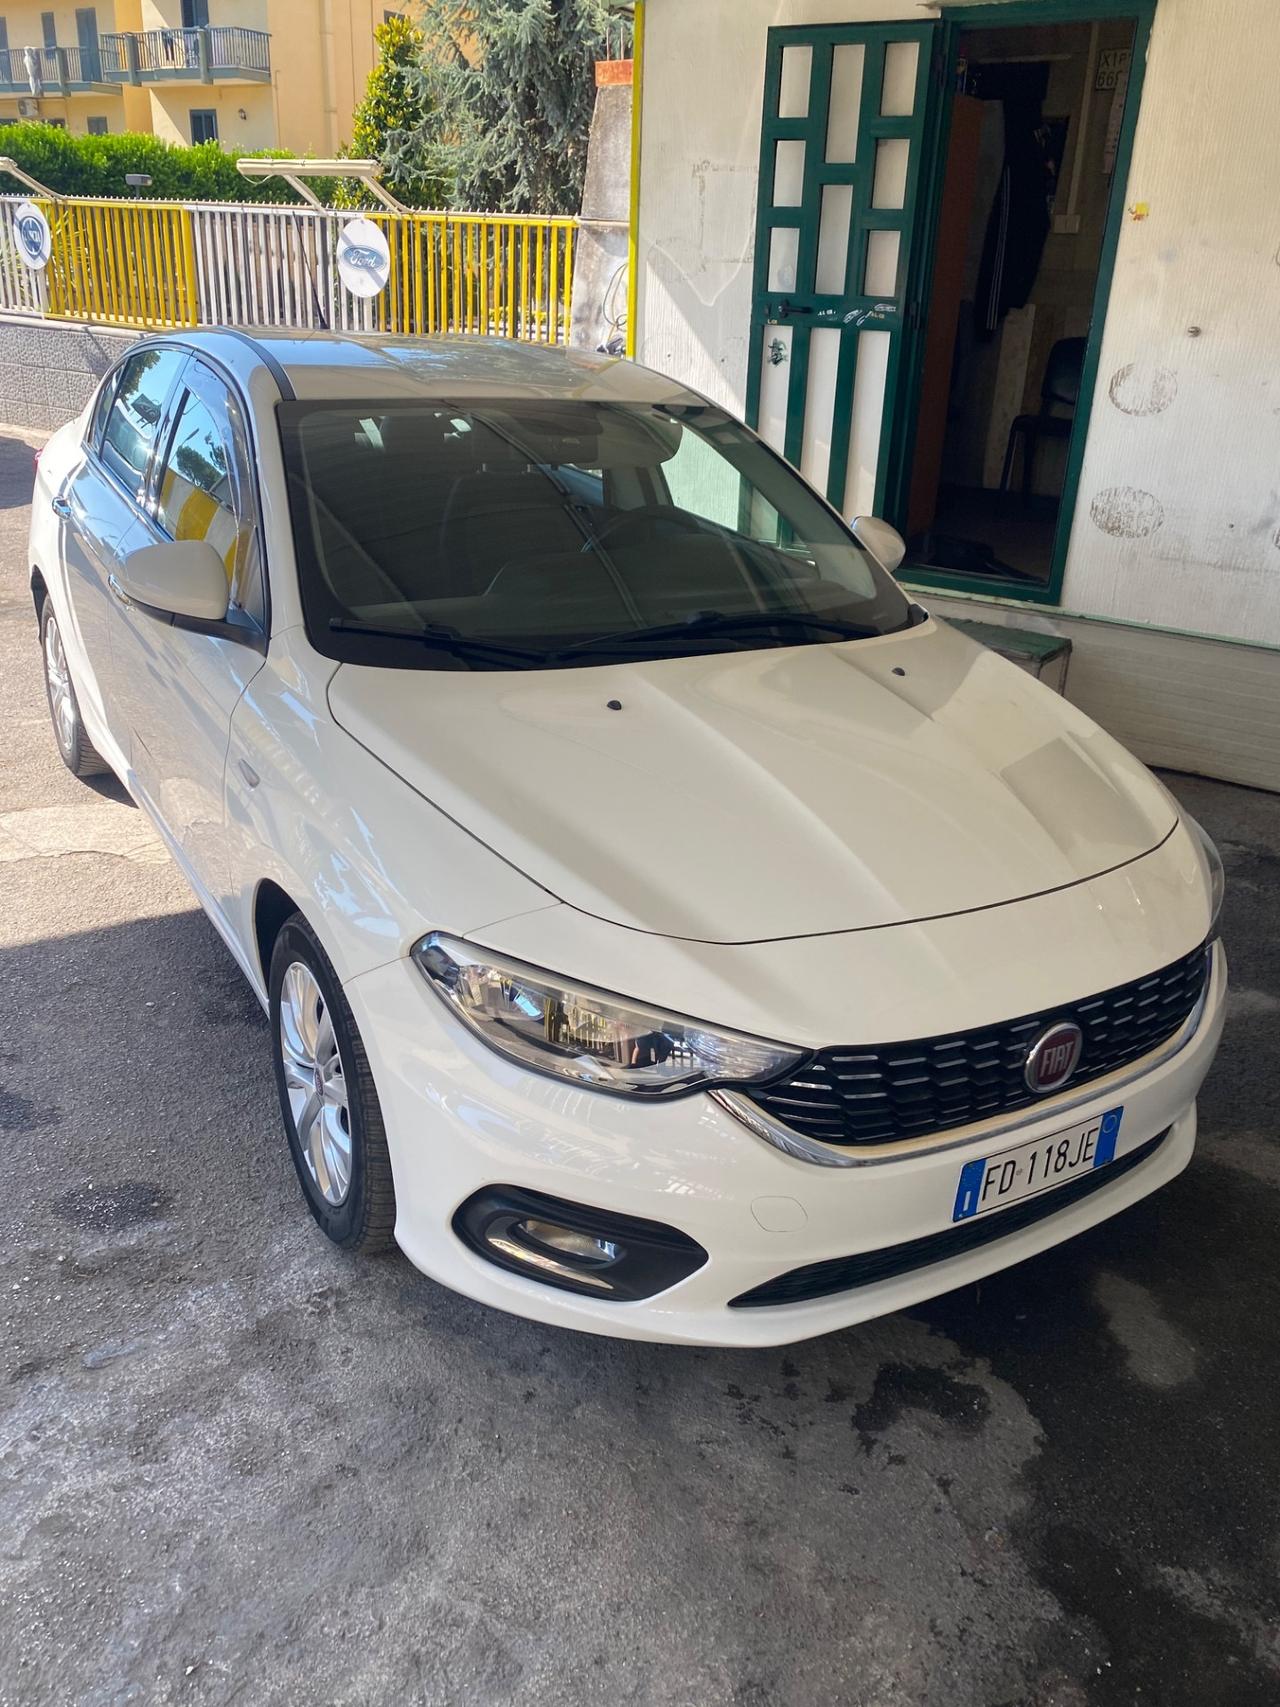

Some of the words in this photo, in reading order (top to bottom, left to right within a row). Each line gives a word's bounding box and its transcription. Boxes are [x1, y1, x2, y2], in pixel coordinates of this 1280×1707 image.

[350, 249, 376, 267] Ford
[1040, 1041, 1074, 1077] FIAT
[982, 1159, 1017, 1201] FD
[1027, 1127, 1099, 1184] 118JE
